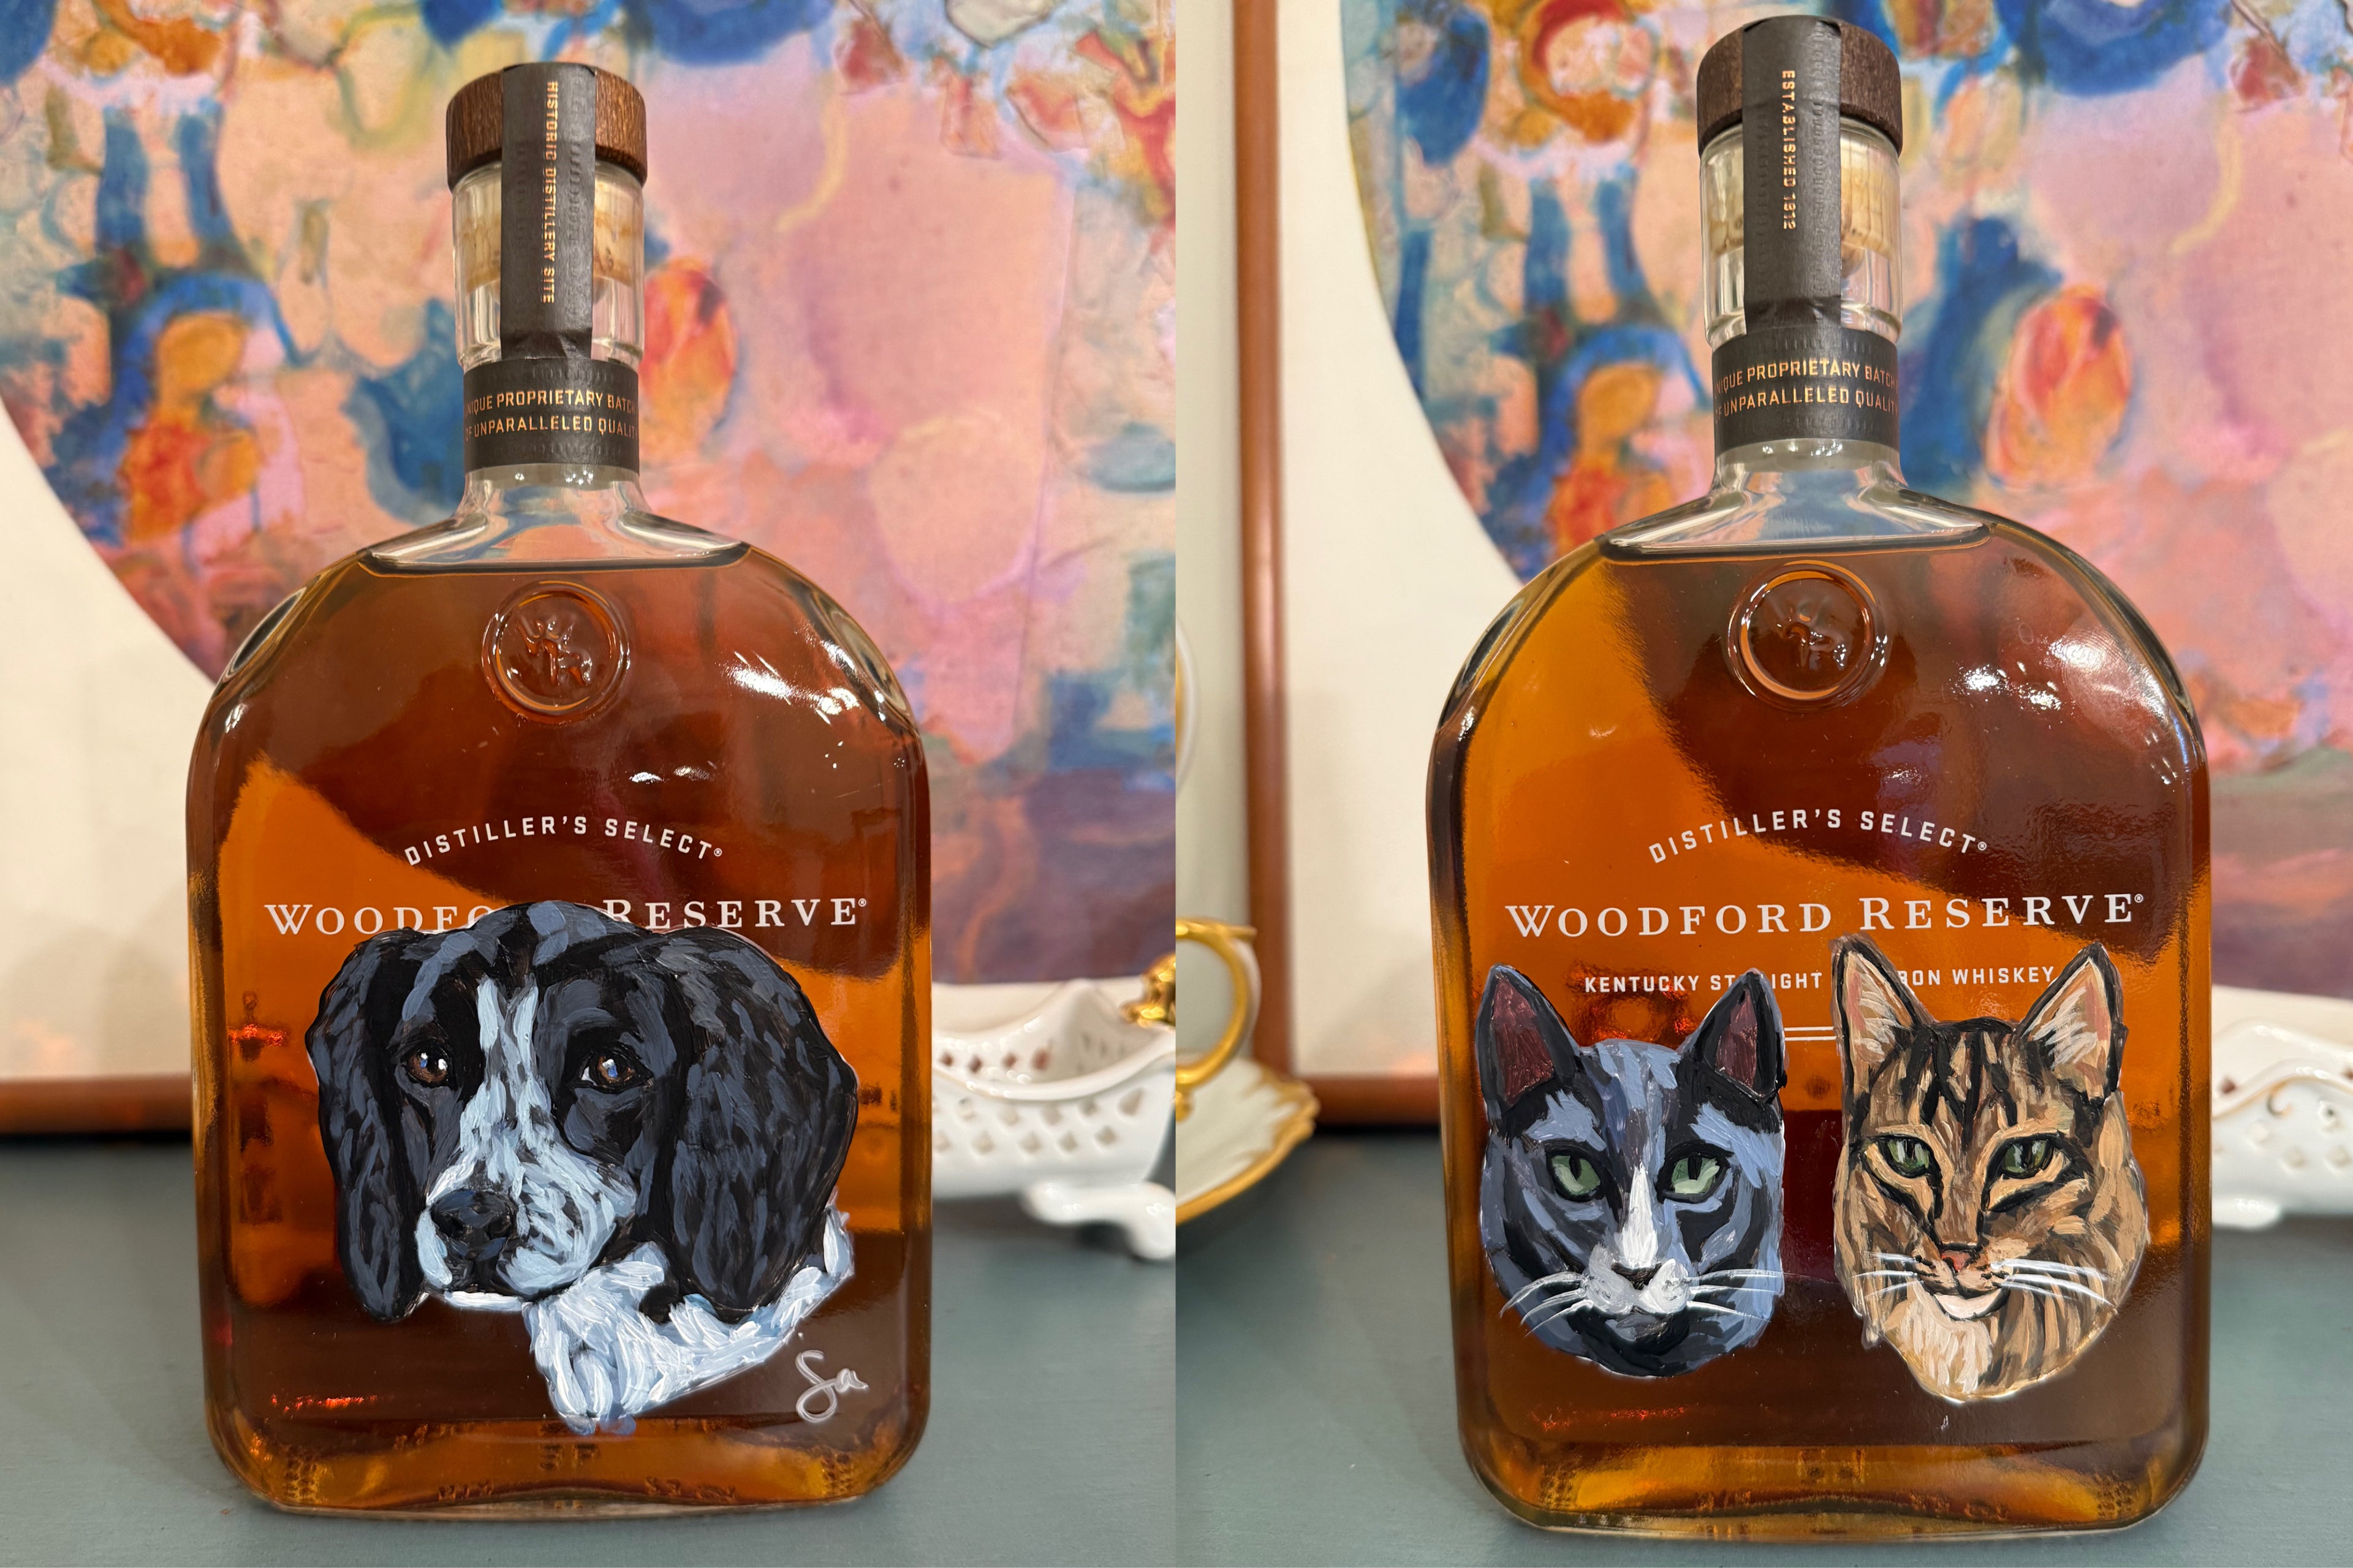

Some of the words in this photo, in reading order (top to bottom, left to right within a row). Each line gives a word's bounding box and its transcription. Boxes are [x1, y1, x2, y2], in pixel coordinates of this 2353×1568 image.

[545, 80, 558, 161] HISTORIC
[1781, 69, 1796, 187] ESTABLISHED
[543, 167, 557, 262] DISTILLERY
[542, 268, 555, 304] SITE
[1747, 357, 1860, 383] PROPRIETARY
[496, 388, 603, 407] PROPRIETARY
[1724, 385, 1849, 417] UNPARALLELED
[474, 415, 592, 438] UNPARALLELED
[1505, 903, 1832, 937] WOODFORD
[1584, 975, 1700, 993] KENTUCKY
[1710, 972, 1822, 991] STIGHT
[1952, 966, 2055, 985] WHISKEY
